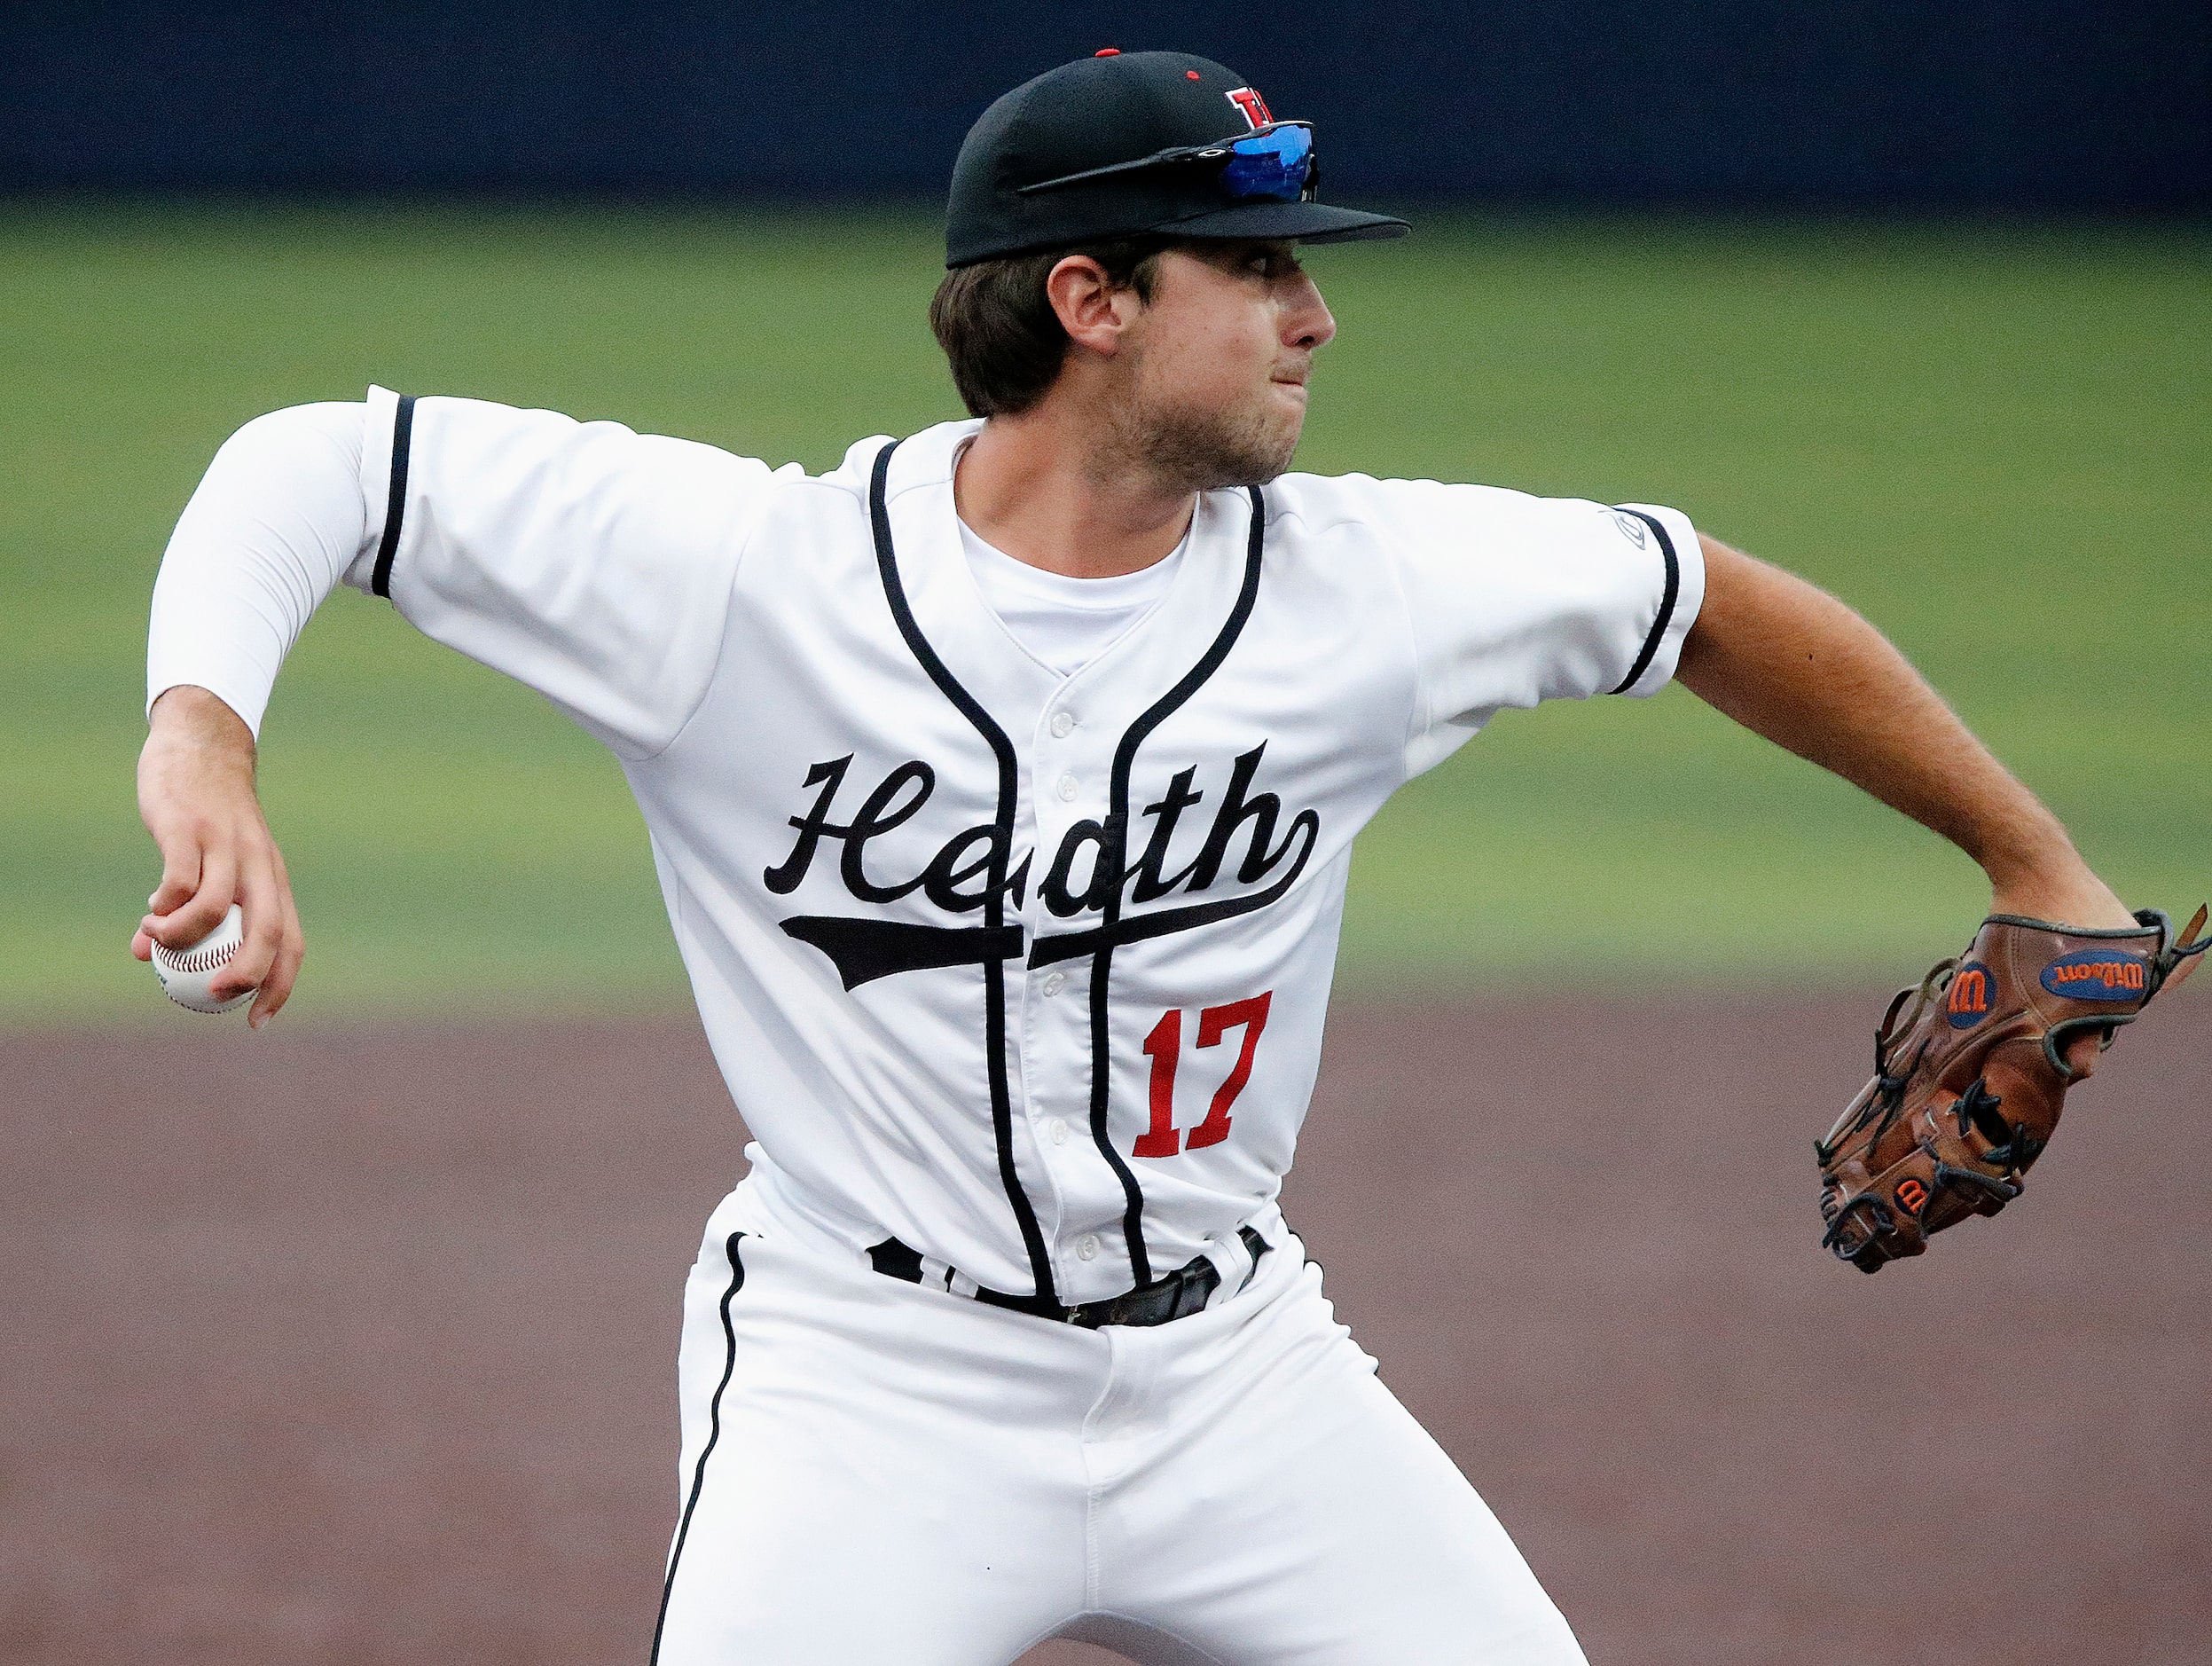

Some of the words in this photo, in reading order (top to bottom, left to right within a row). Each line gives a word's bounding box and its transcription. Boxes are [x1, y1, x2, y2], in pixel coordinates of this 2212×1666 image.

[764, 739, 1320, 918] Heath
[1948, 970, 1988, 1014] W
[2053, 962, 2144, 990] Wilson
[1132, 990, 1273, 1158] 17
